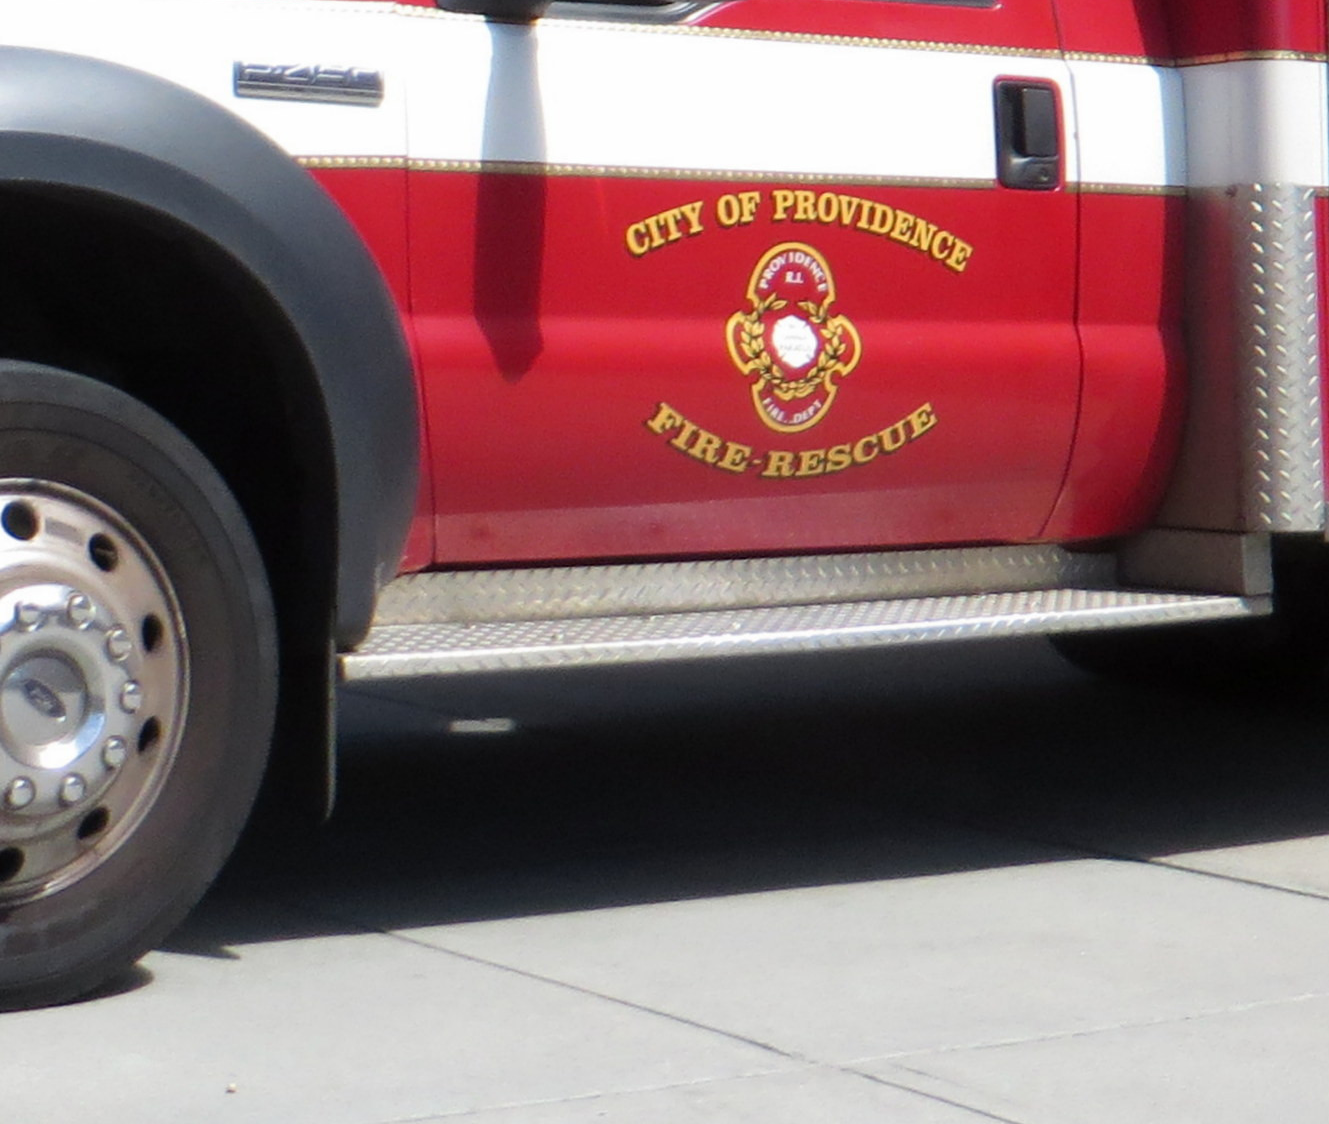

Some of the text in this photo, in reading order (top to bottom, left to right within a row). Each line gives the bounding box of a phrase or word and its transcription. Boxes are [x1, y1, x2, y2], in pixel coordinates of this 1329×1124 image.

[625, 189, 974, 273] CITY OF PROVIDENCE
[759, 251, 829, 293] PROVIDENCE
[645, 401, 938, 479] FIRE-RESCUE
